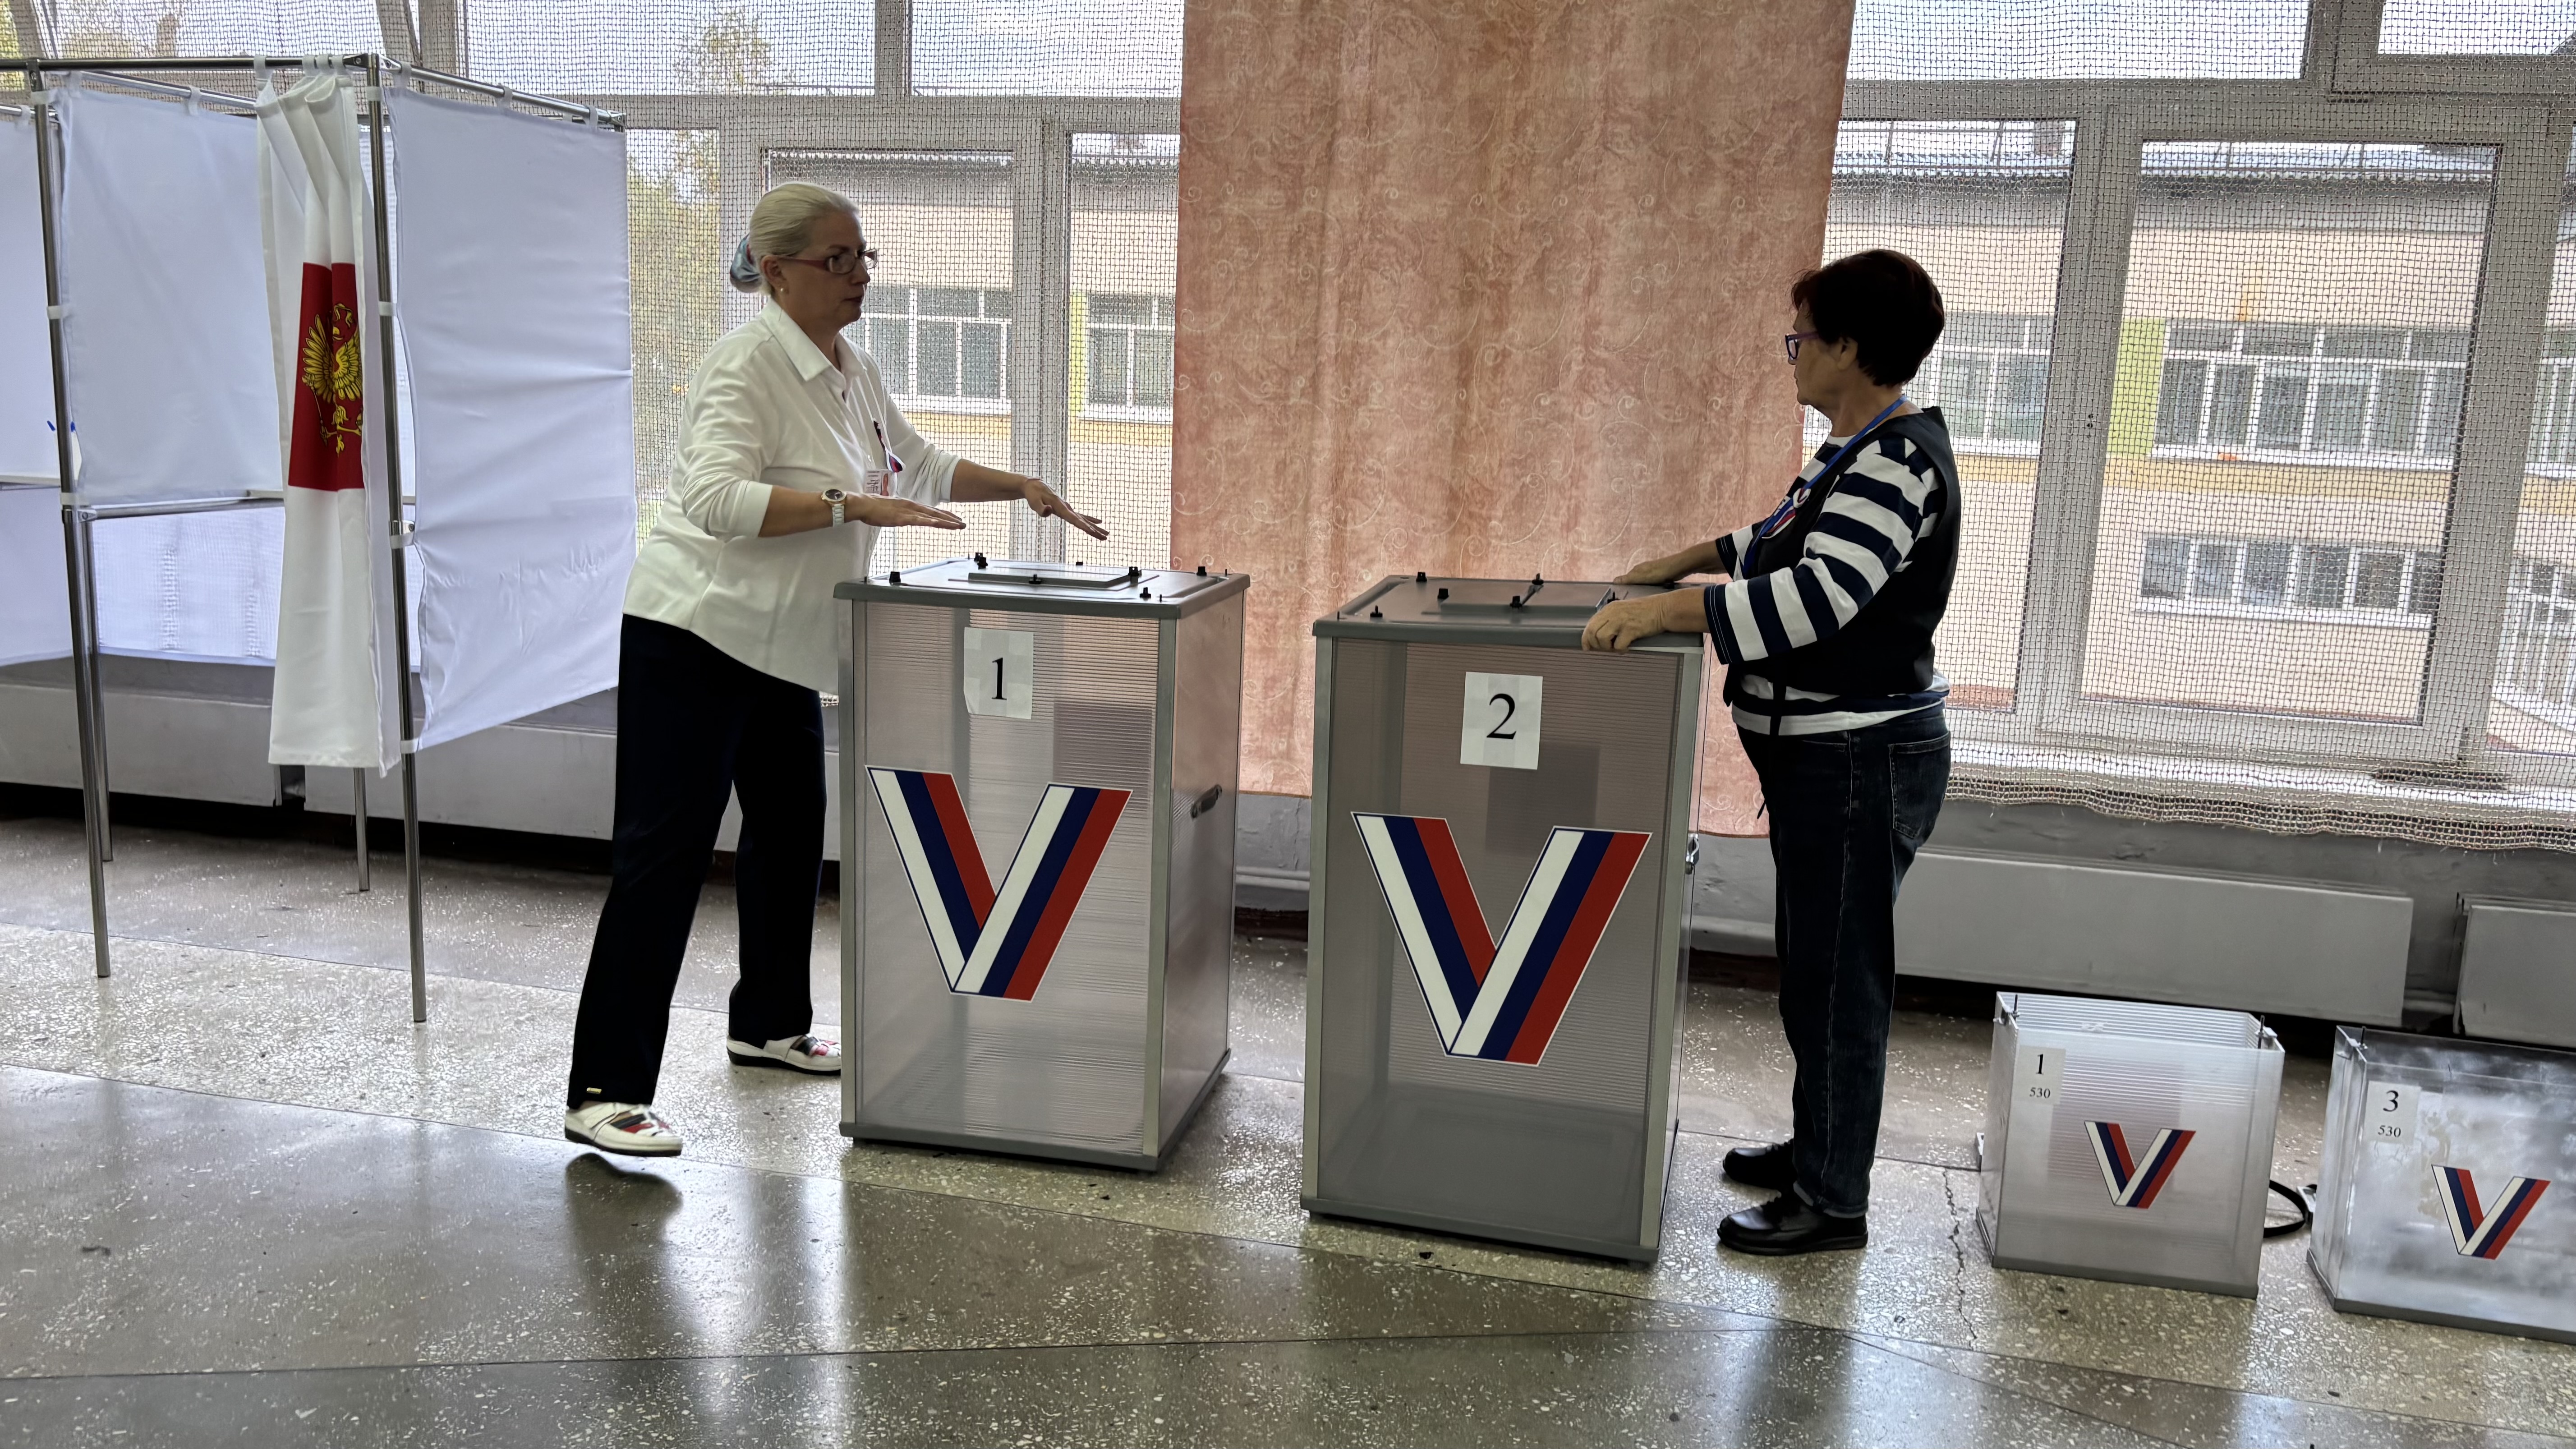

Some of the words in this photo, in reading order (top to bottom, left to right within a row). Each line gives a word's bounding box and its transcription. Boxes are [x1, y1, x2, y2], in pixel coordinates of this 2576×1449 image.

[991, 657, 1007, 700] 1
[1486, 693, 1516, 740] 2
[2036, 1053, 2044, 1075] 1
[2029, 1087, 2051, 1099] 530
[2383, 1090, 2399, 1112] 3
[2378, 1125, 2401, 1138] 530
